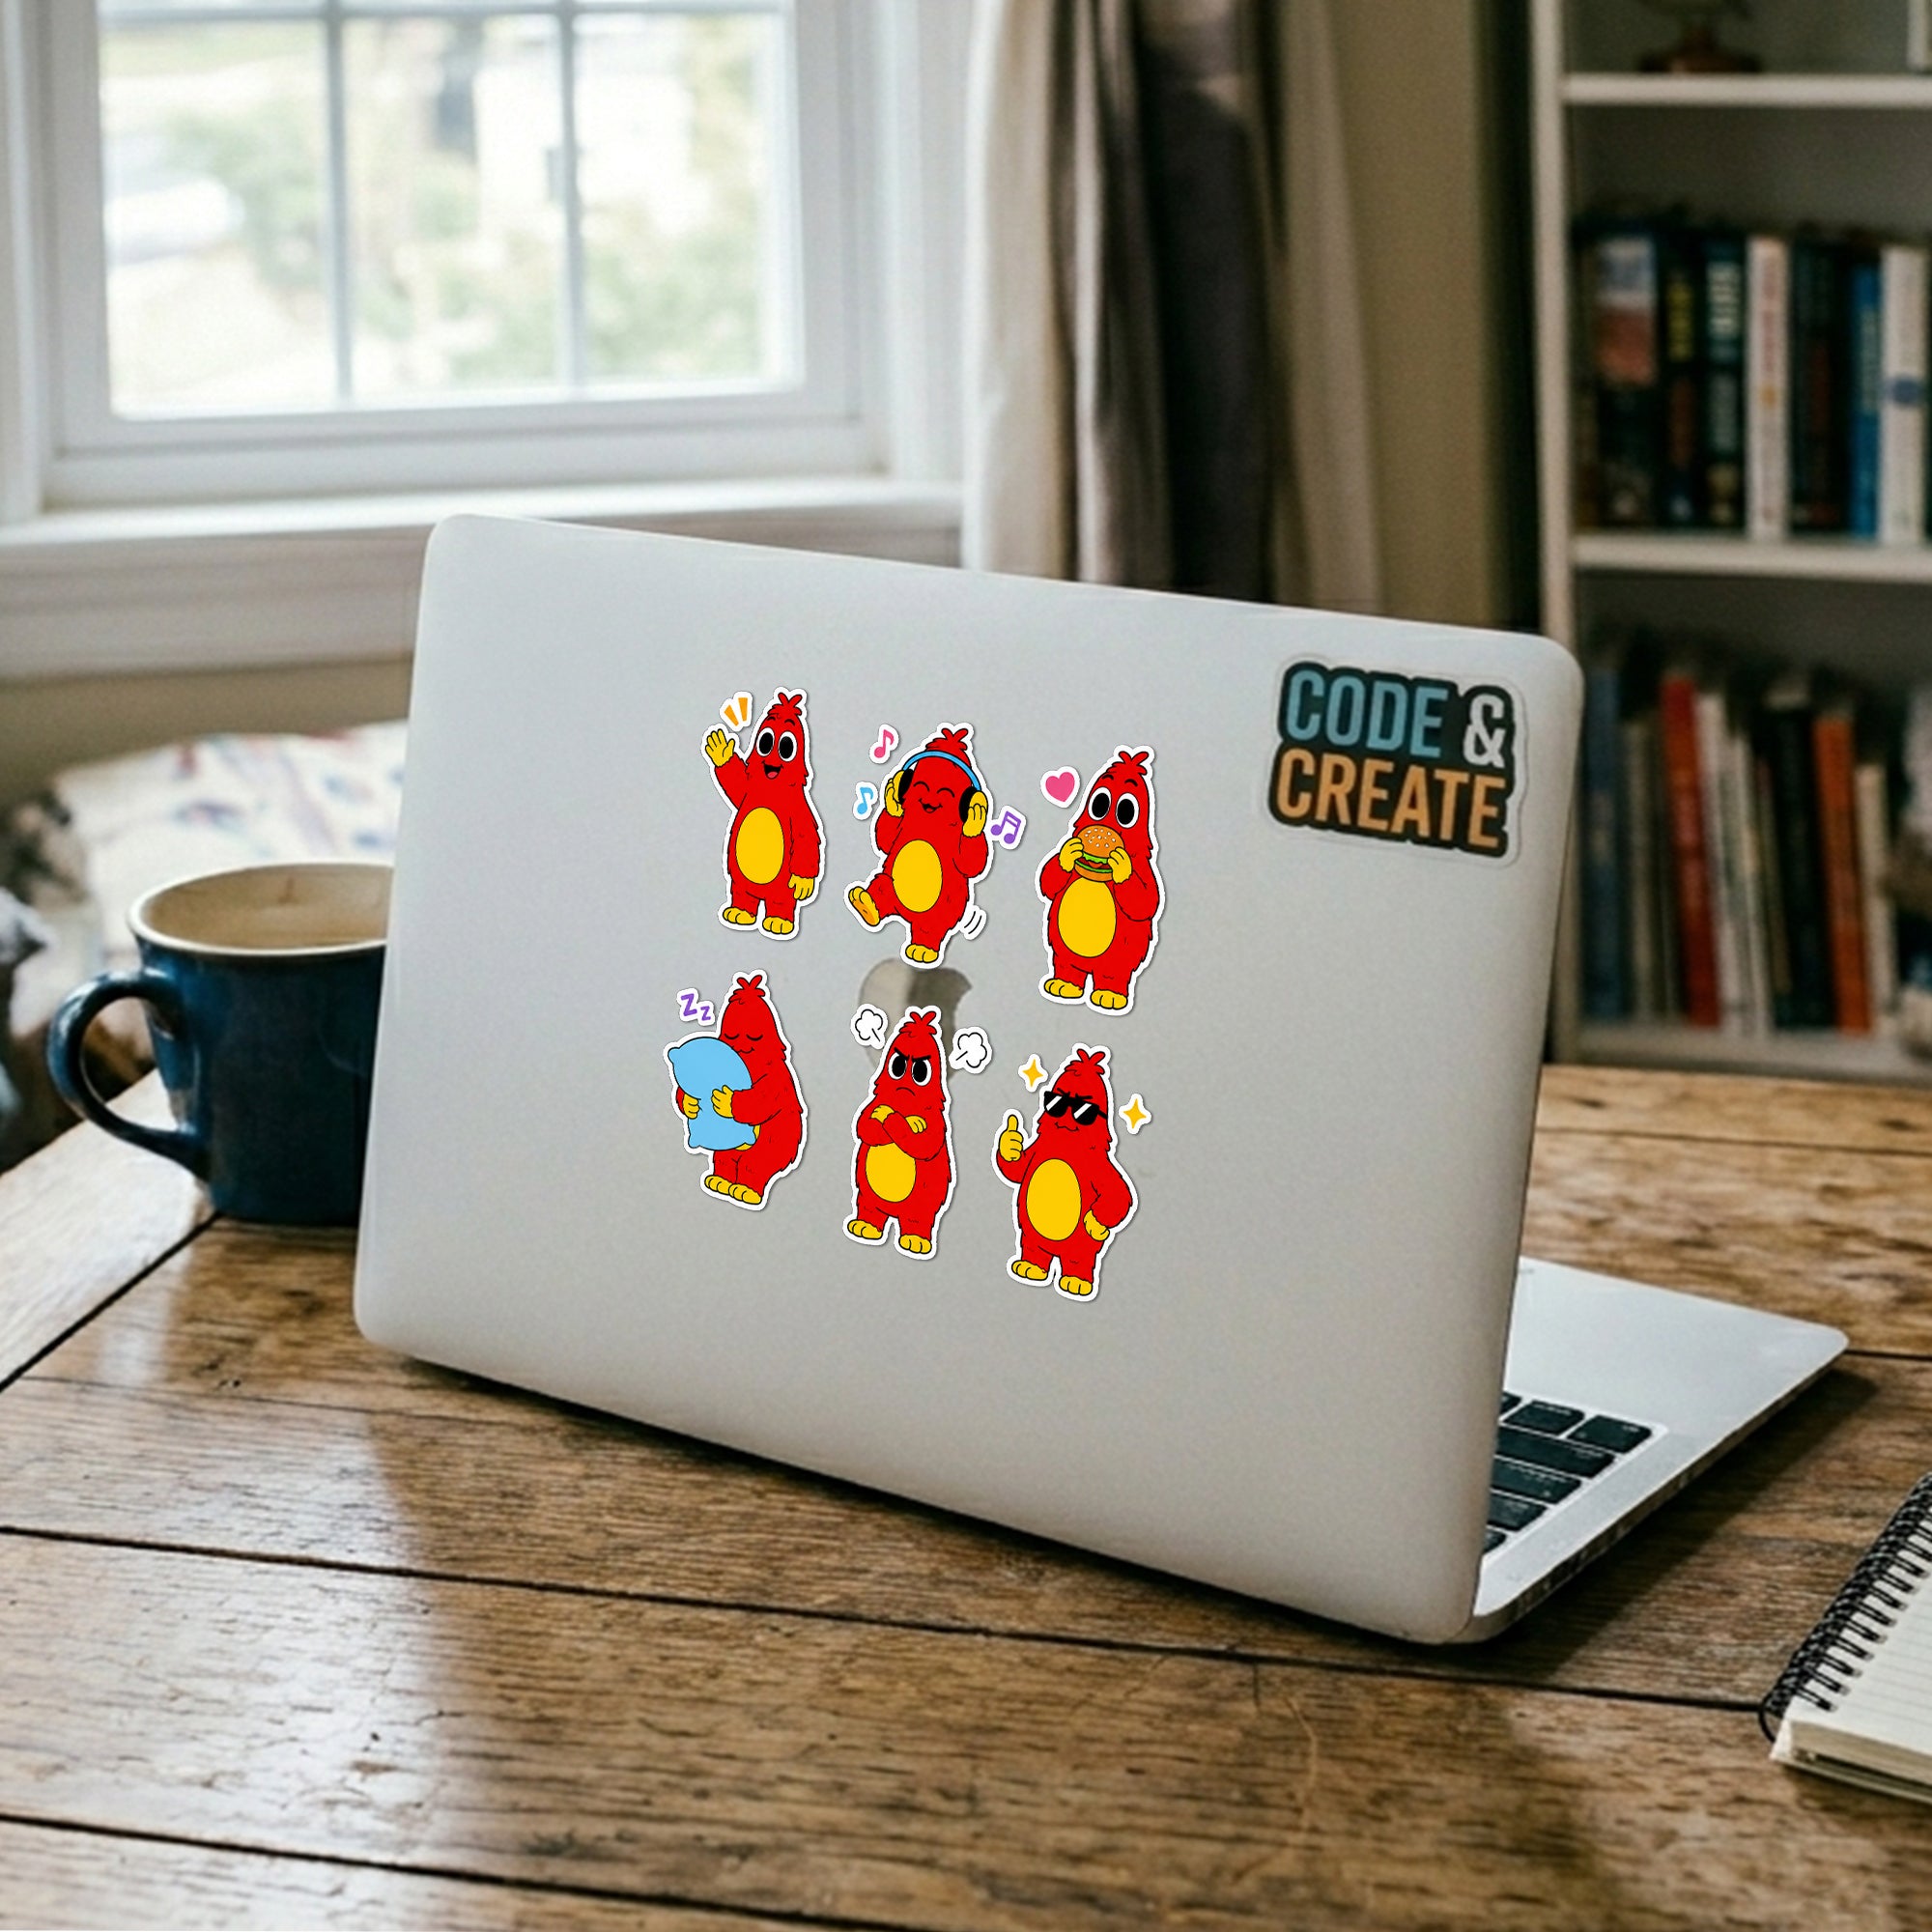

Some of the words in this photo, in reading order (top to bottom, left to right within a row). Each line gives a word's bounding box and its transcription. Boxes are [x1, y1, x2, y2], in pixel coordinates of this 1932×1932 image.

[1286, 669, 1448, 758] CODE
[1463, 693, 1506, 768] &
[1276, 747, 1506, 848] CREATE
